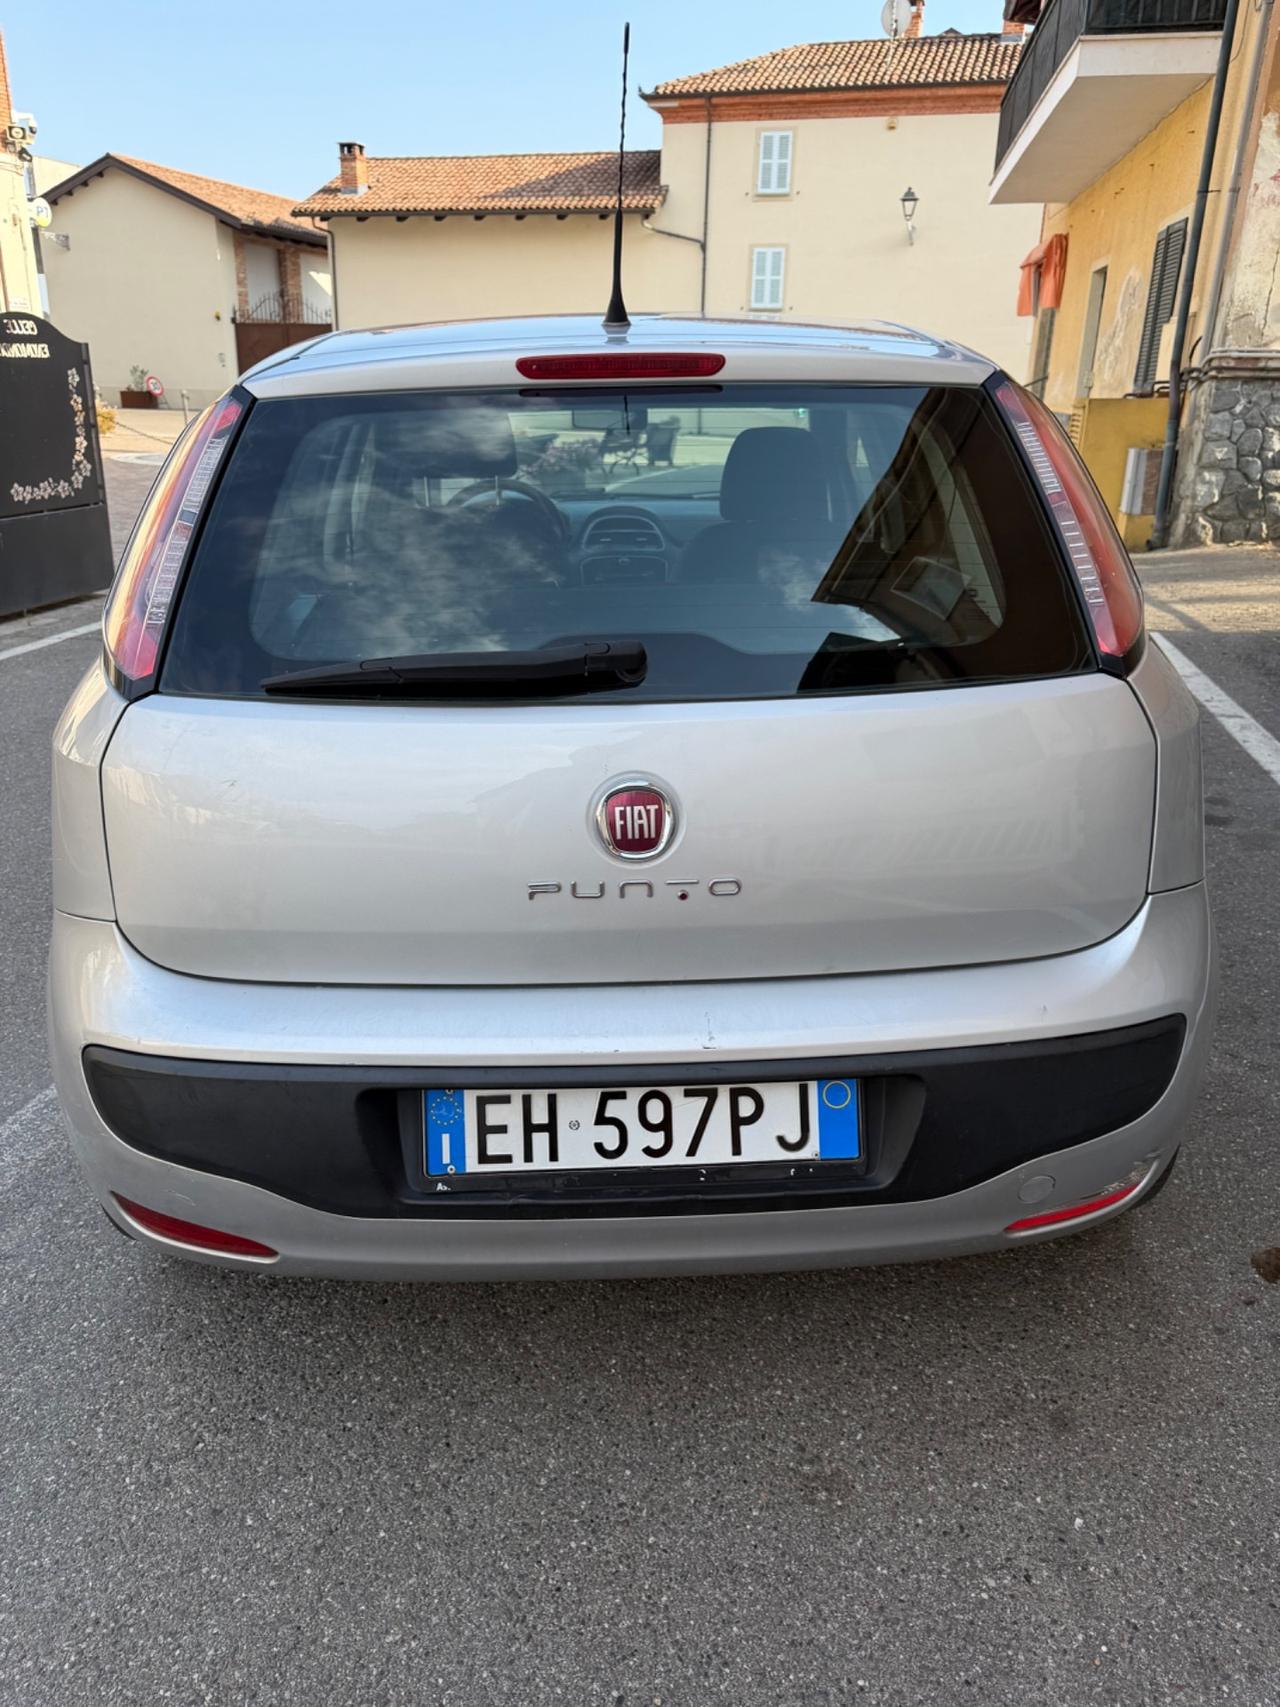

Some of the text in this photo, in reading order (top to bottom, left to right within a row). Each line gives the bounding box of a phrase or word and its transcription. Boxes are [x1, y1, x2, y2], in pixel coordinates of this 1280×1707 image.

[614, 804, 659, 840] FIAT
[527, 877, 742, 900] PUNTO
[475, 1093, 559, 1165] EH
